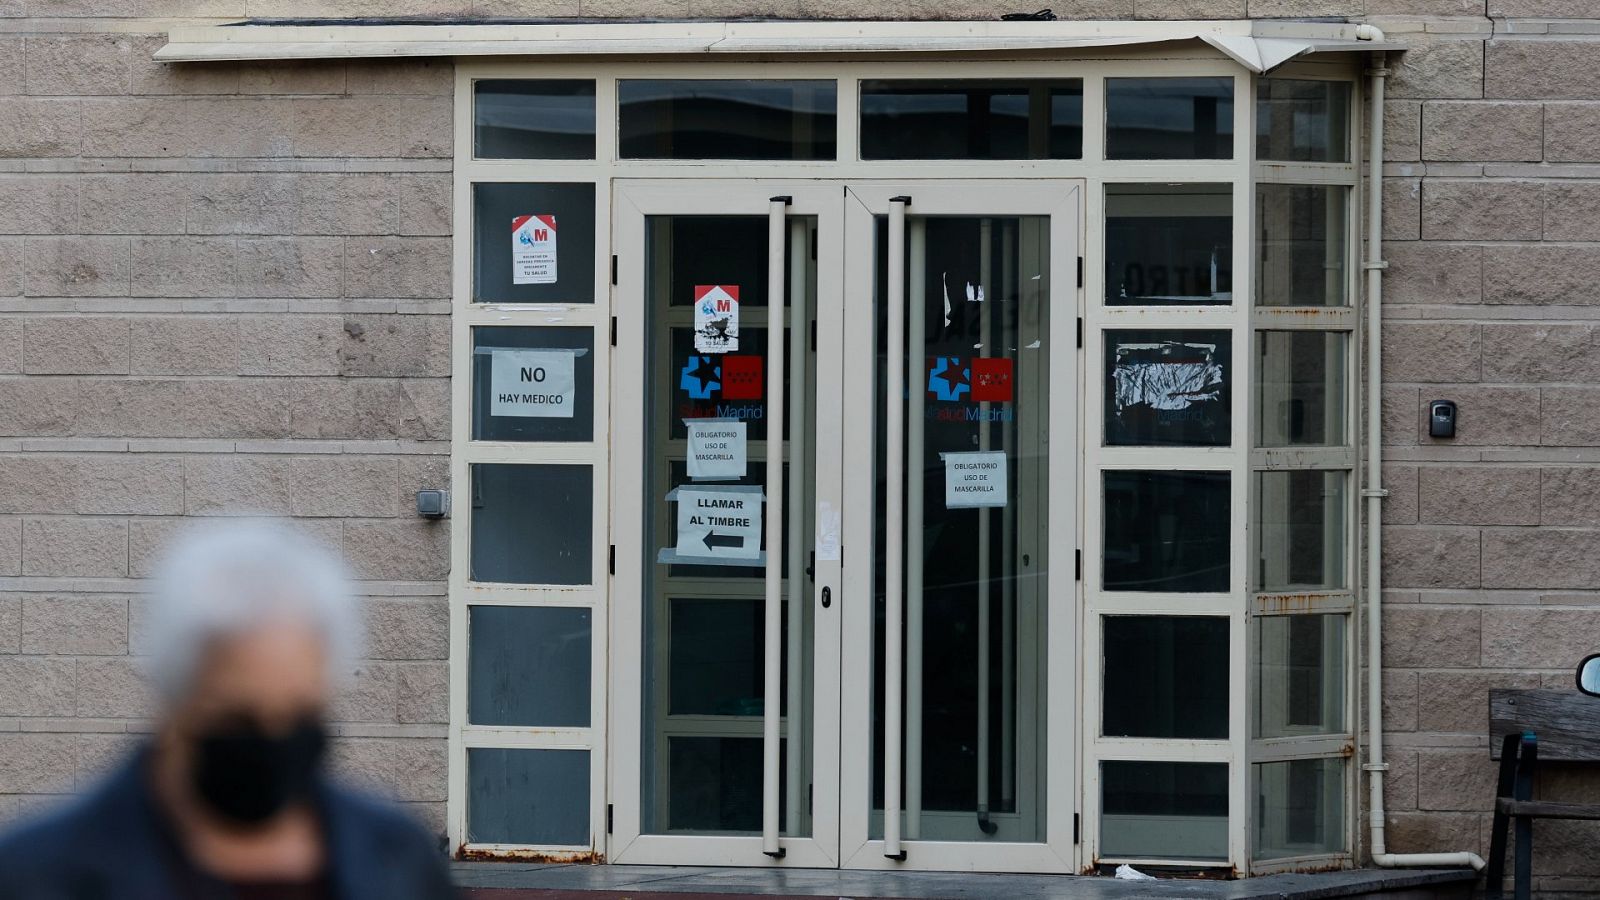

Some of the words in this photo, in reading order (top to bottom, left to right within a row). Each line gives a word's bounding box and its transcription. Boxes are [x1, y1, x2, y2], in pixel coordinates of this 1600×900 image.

[520, 367, 546, 382] NO
[499, 393, 520, 403] HAY
[522, 394, 563, 404] MEDICO
[695, 431, 737, 439] OBLIGATORIO
[954, 485, 994, 493] MASCARILLA
[697, 499, 744, 509] LLAMAR
[689, 516, 704, 525] AL
[707, 516, 750, 527] TIMBRE
